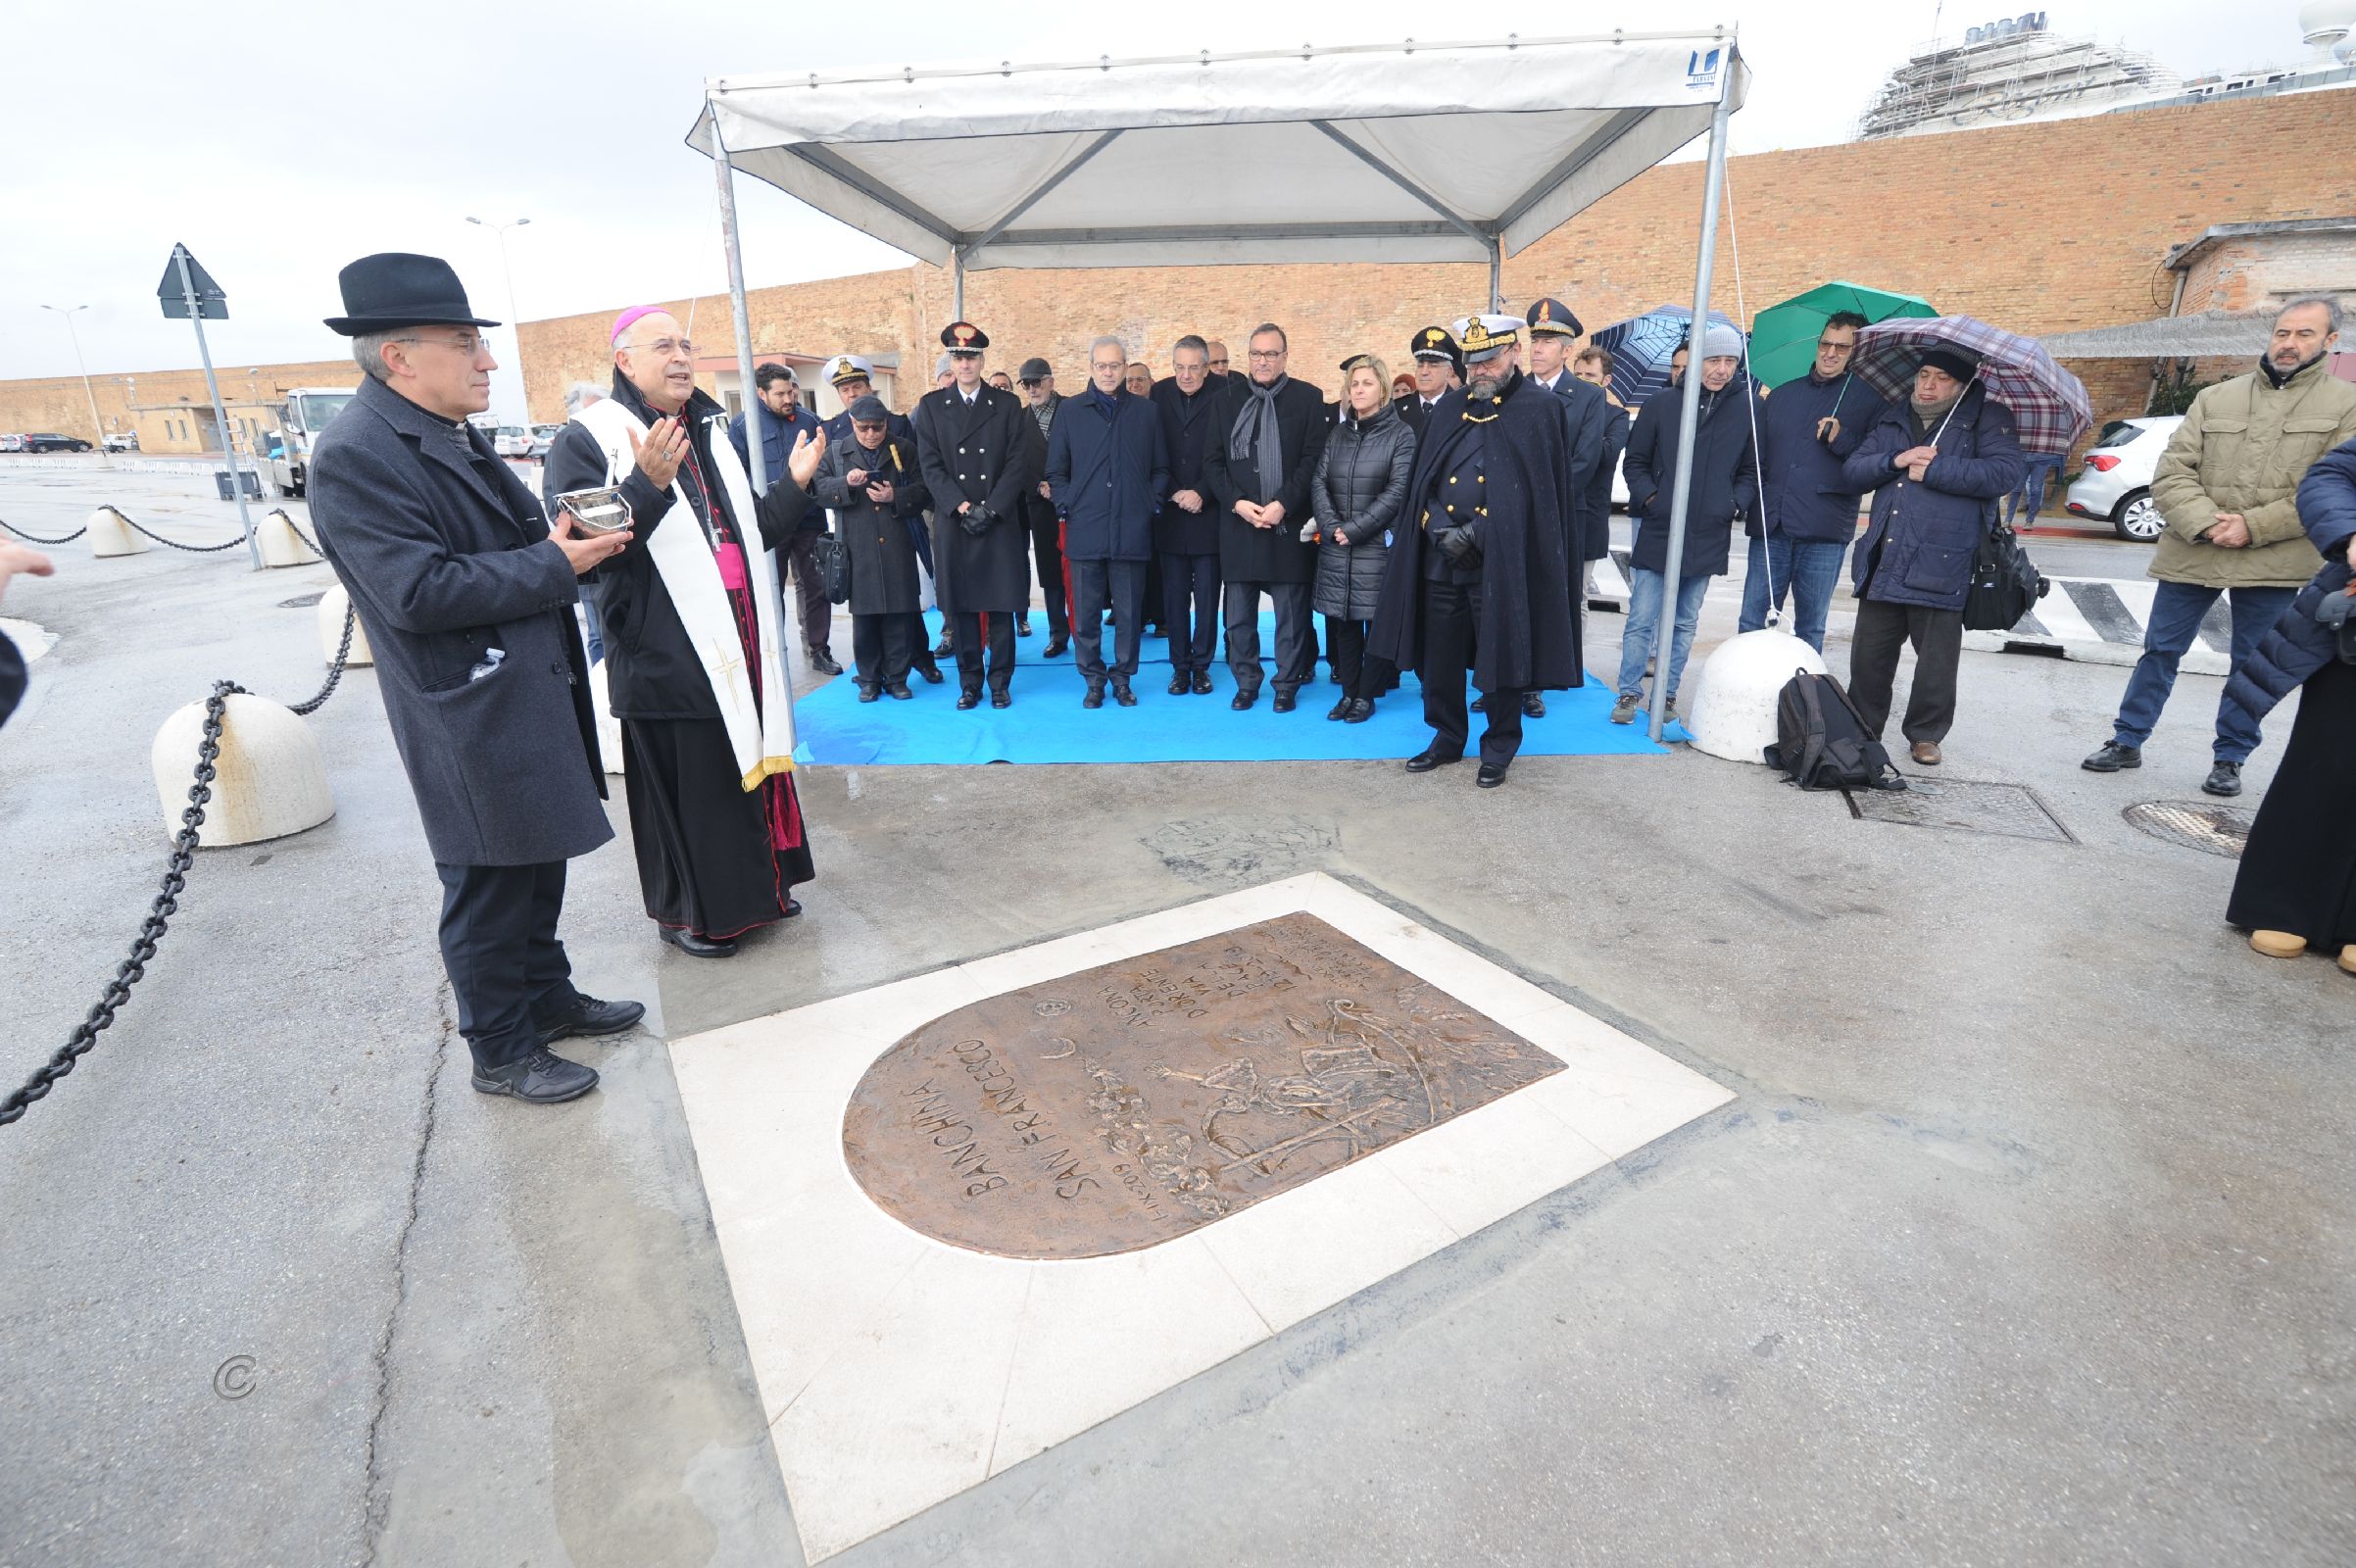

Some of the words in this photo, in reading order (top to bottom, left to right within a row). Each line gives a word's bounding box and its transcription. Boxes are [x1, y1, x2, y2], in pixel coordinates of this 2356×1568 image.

[1181, 974, 1211, 996] VIA
[1197, 961, 1248, 997] DELLA
[1217, 962, 1264, 989] PACE
[1096, 984, 1155, 1028] ANCONA
[1127, 983, 1173, 1016] PORTA
[952, 1037, 1057, 1147] FRANCESCO
[908, 1077, 1010, 1197] BANCHINA
[1035, 1148, 1102, 1198] SAN
